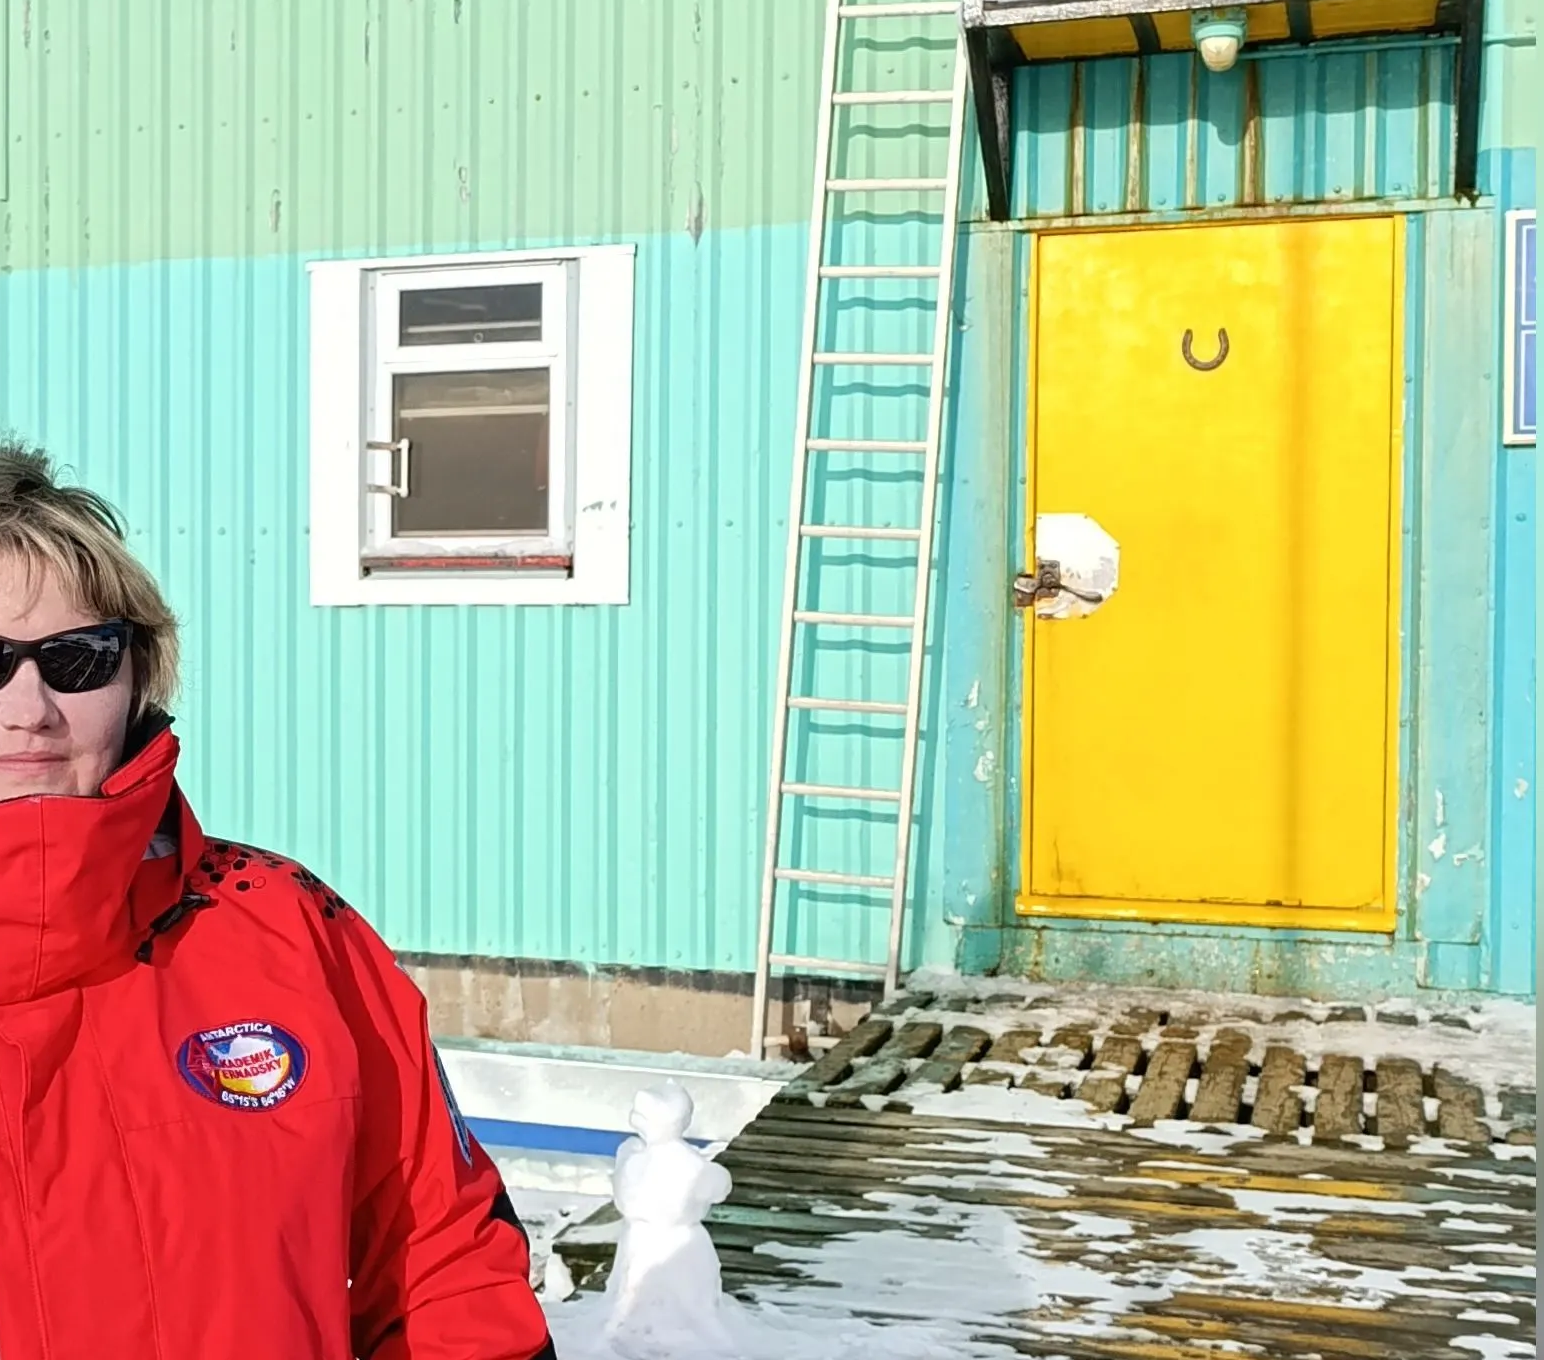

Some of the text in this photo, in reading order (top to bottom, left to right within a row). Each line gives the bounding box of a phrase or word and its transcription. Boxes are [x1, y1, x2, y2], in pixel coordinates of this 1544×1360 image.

[200, 1023, 274, 1043] ANTARCTICA
[216, 1048, 275, 1070] KADEMIK
[219, 1057, 282, 1080] ERNADSKY
